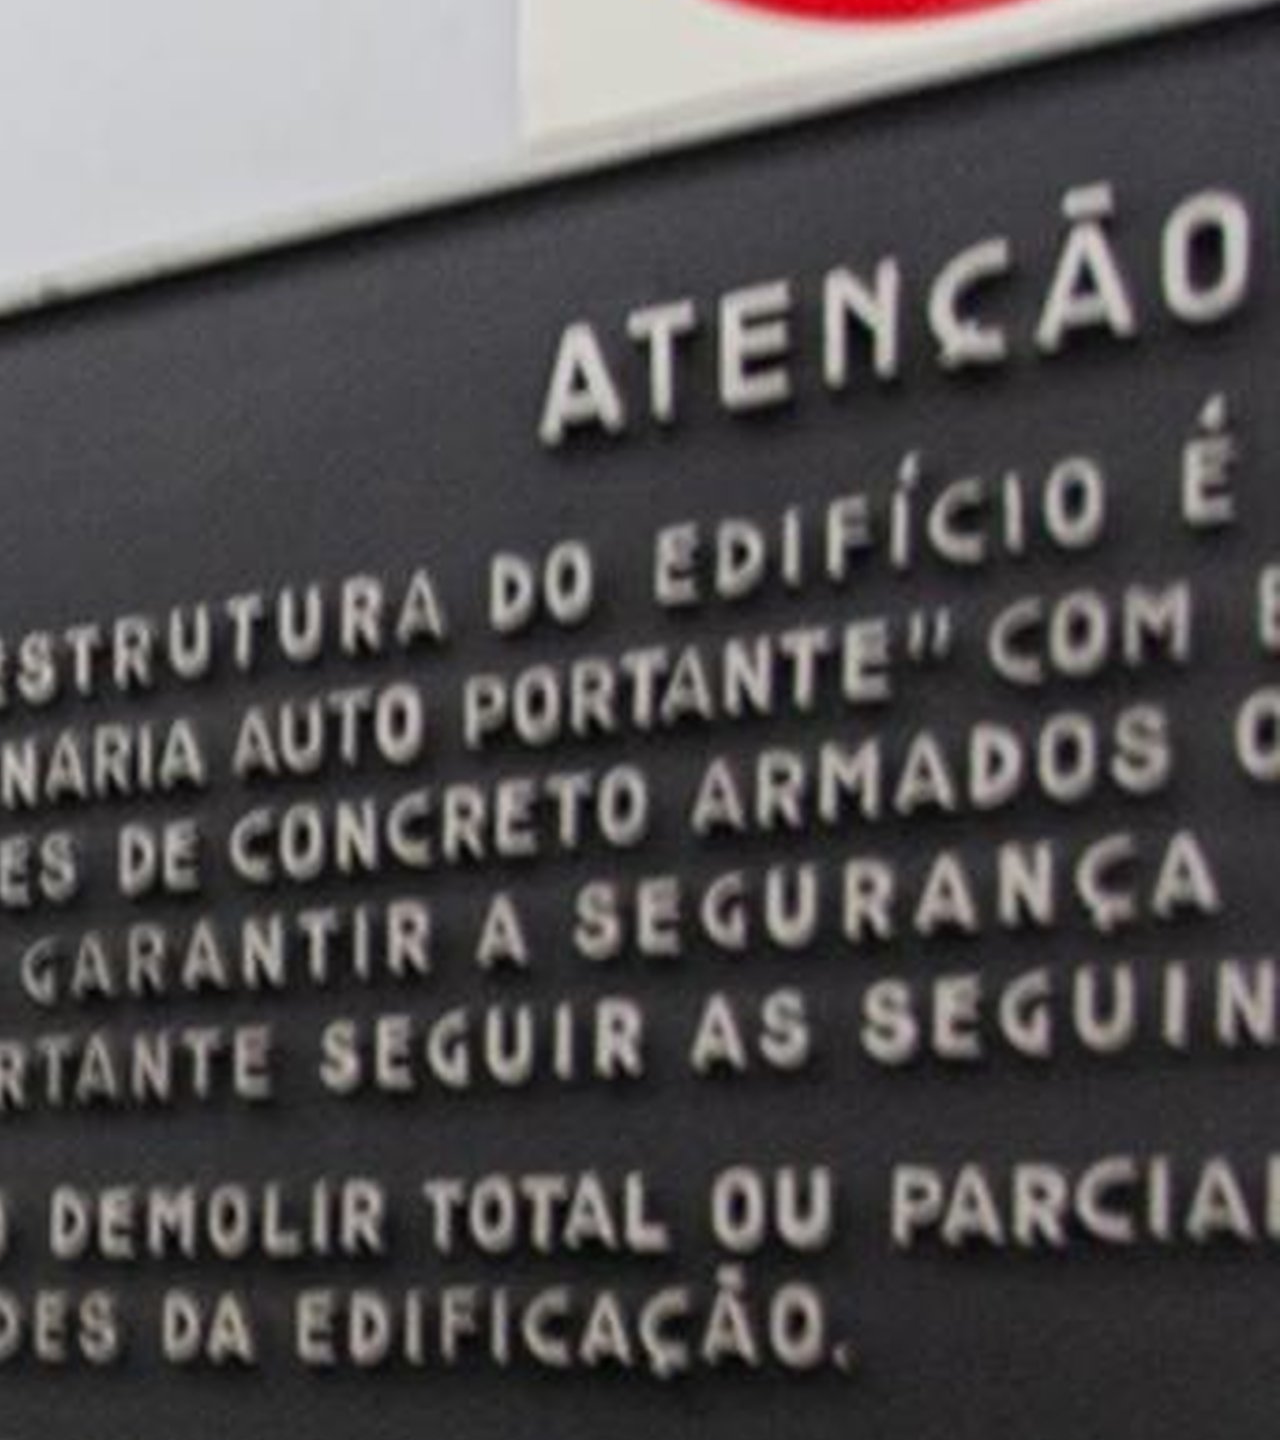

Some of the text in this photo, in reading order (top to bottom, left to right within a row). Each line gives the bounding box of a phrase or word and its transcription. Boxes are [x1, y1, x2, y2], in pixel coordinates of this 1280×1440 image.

[538, 180, 1251, 448] ATENÇÃO
[489, 541, 594, 633] DO
[653, 450, 1105, 606] EDIFÍCIO
[1181, 392, 1234, 525] É
[233, 682, 424, 777] AUTO
[987, 578, 1192, 685] COM
[117, 818, 200, 898] DE
[230, 763, 647, 882] CONCRETO
[691, 703, 1171, 837] ARMADOS
[19, 897, 432, 1007] GARANTIR
[476, 892, 528, 969] A
[571, 828, 1220, 960] SEGURANÇA
[319, 995, 642, 1097] SEGUIR
[690, 988, 809, 1074] AS
[48, 1176, 385, 1260] DEMOLIR
[424, 1168, 669, 1254] TOTAL
[711, 1162, 833, 1252] OU
[161, 1288, 254, 1360] DA
